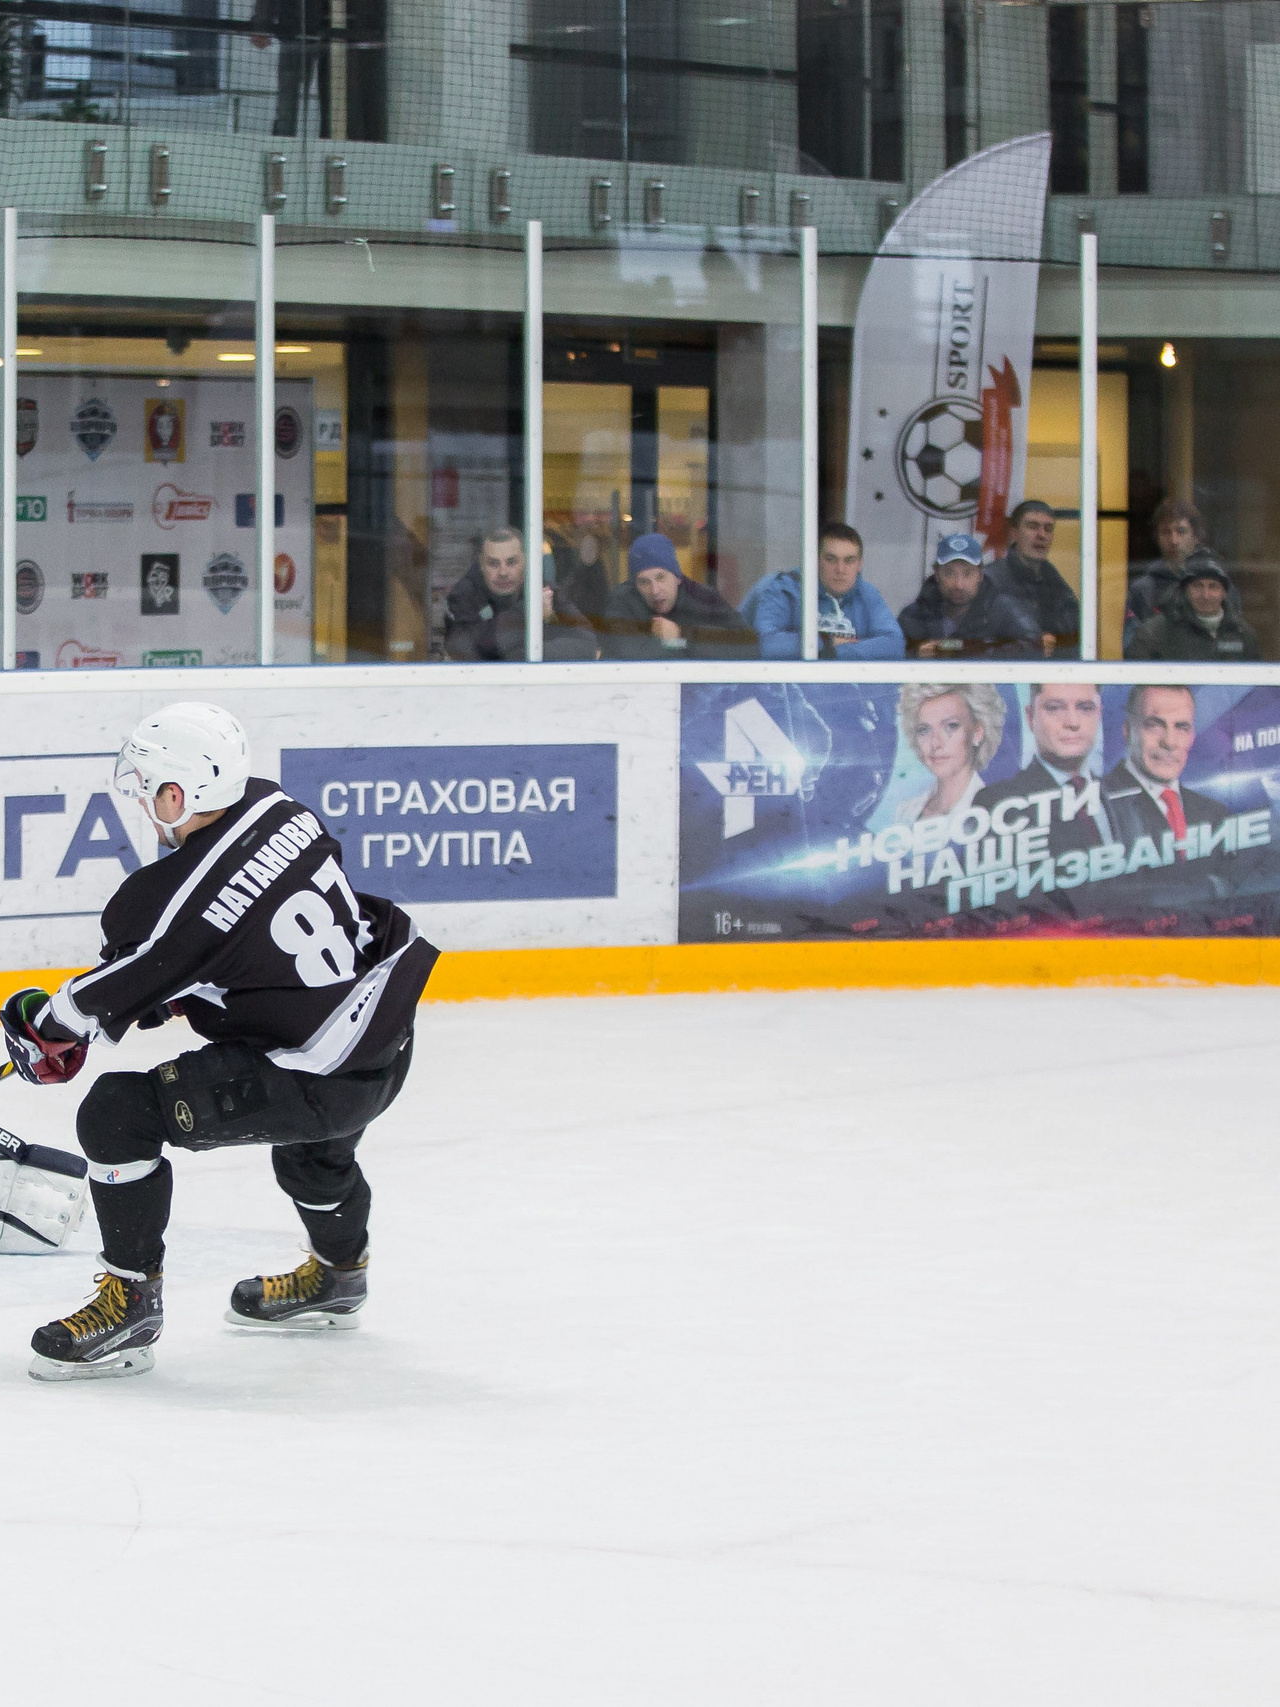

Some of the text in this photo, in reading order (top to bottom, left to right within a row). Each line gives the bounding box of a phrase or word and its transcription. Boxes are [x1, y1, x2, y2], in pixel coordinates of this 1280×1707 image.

[947, 279, 974, 390] SPORT
[1234, 733, 1254, 752] НА
[322, 777, 575, 817] СТРАХОВАЯ
[835, 780, 1101, 872] НОВОСТИ
[362, 830, 533, 868] ГРУППА
[888, 827, 1051, 895] НАШЕ
[948, 810, 1272, 915] ПРИЗВАНИЕ
[270, 854, 374, 988] 87
[715, 912, 744, 935] 16+
